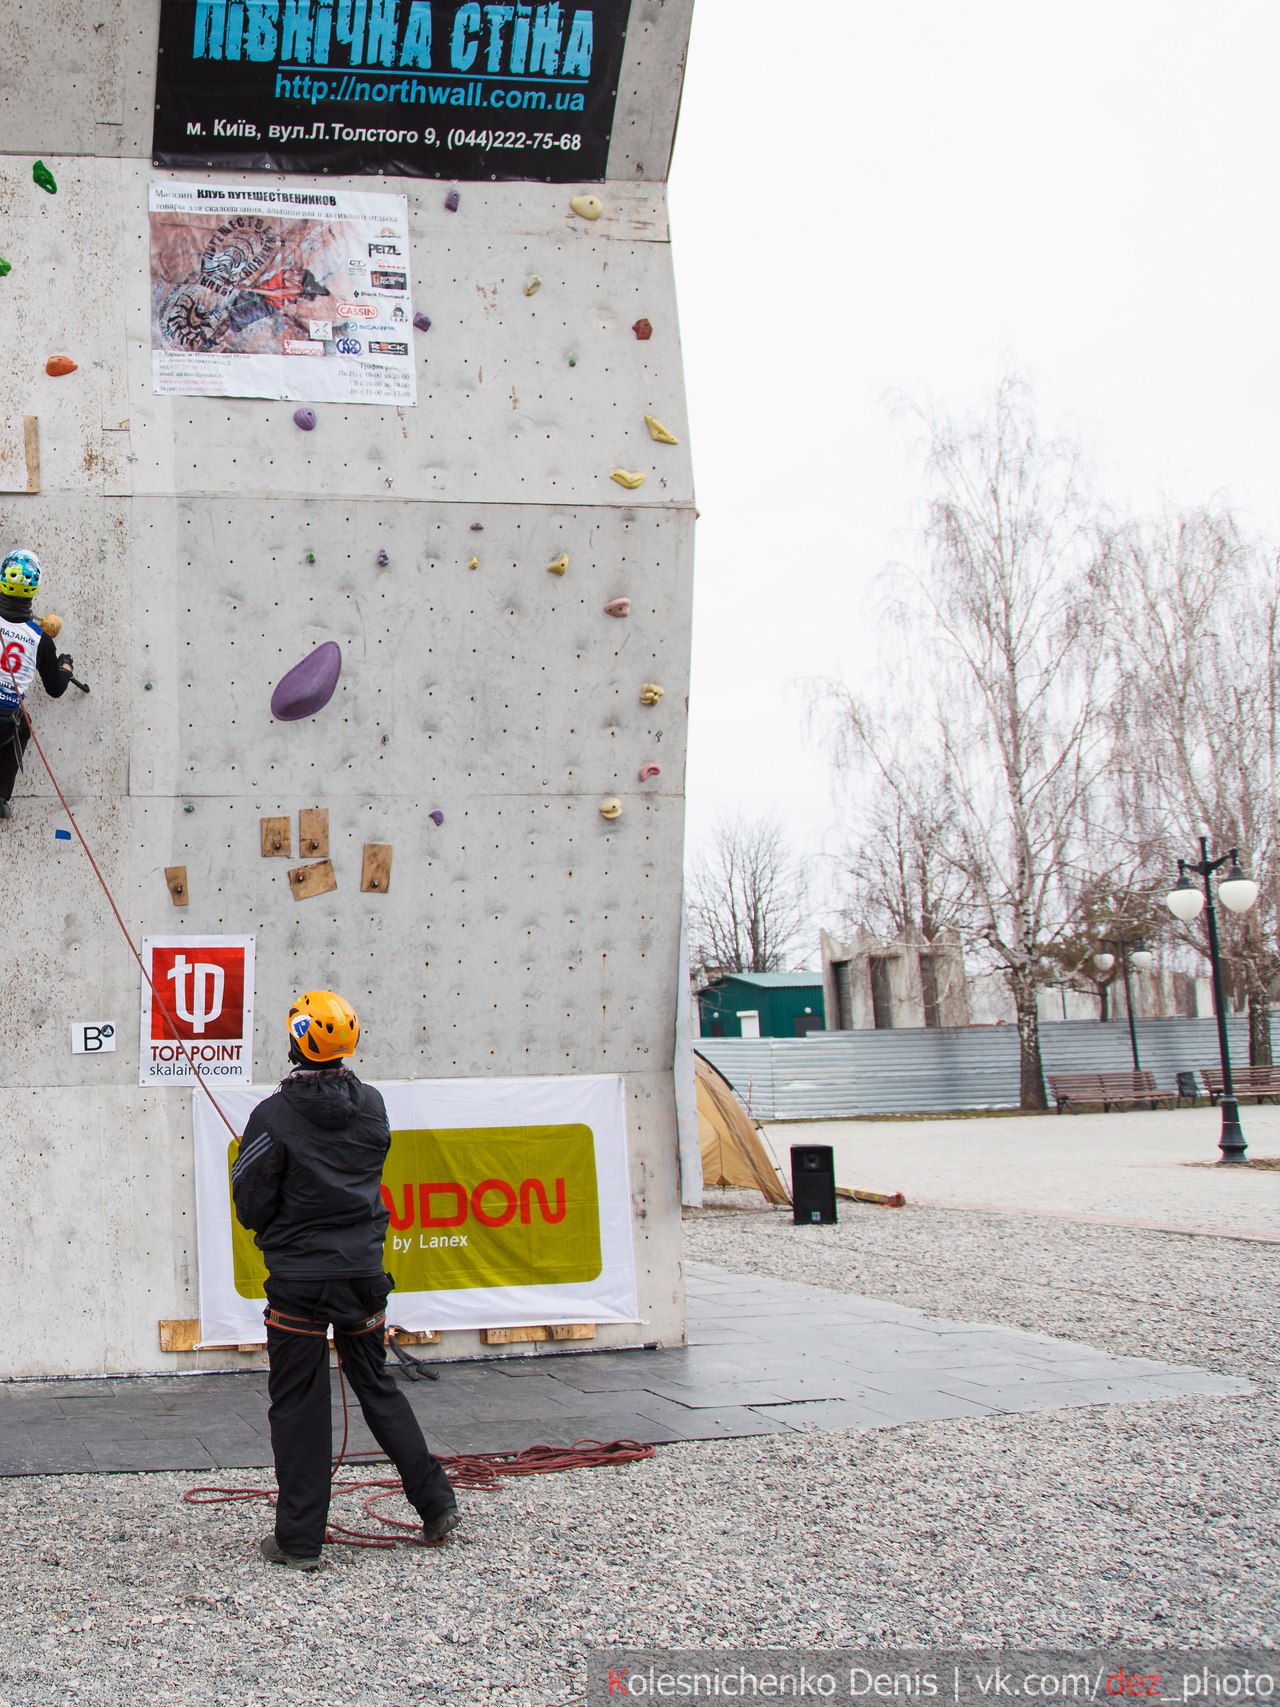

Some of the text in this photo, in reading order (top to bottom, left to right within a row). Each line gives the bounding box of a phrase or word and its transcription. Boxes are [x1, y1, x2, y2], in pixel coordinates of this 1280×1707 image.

[193, 0, 593, 77] ПІВНІЧНА СТІНА
[275, 74, 585, 111] http://northwall.com.ua
[186, 122, 206, 135] м.
[213, 119, 261, 140] Київ,
[424, 128, 440, 147] 9,
[447, 128, 581, 151] (044)222-75-68
[155, 189, 337, 206] Магазин КЛУБ ПУТЕШЕСТВЕННИКОВ
[368, 243, 401, 258] PETZL
[340, 306, 375, 316] CASSIN
[84, 1026, 103, 1051] B
[151, 1045, 243, 1061] TOP POINT
[150, 1063, 243, 1076] skalainfo.com
[393, 1236, 412, 1253] by
[420, 1234, 468, 1249] Lanex
